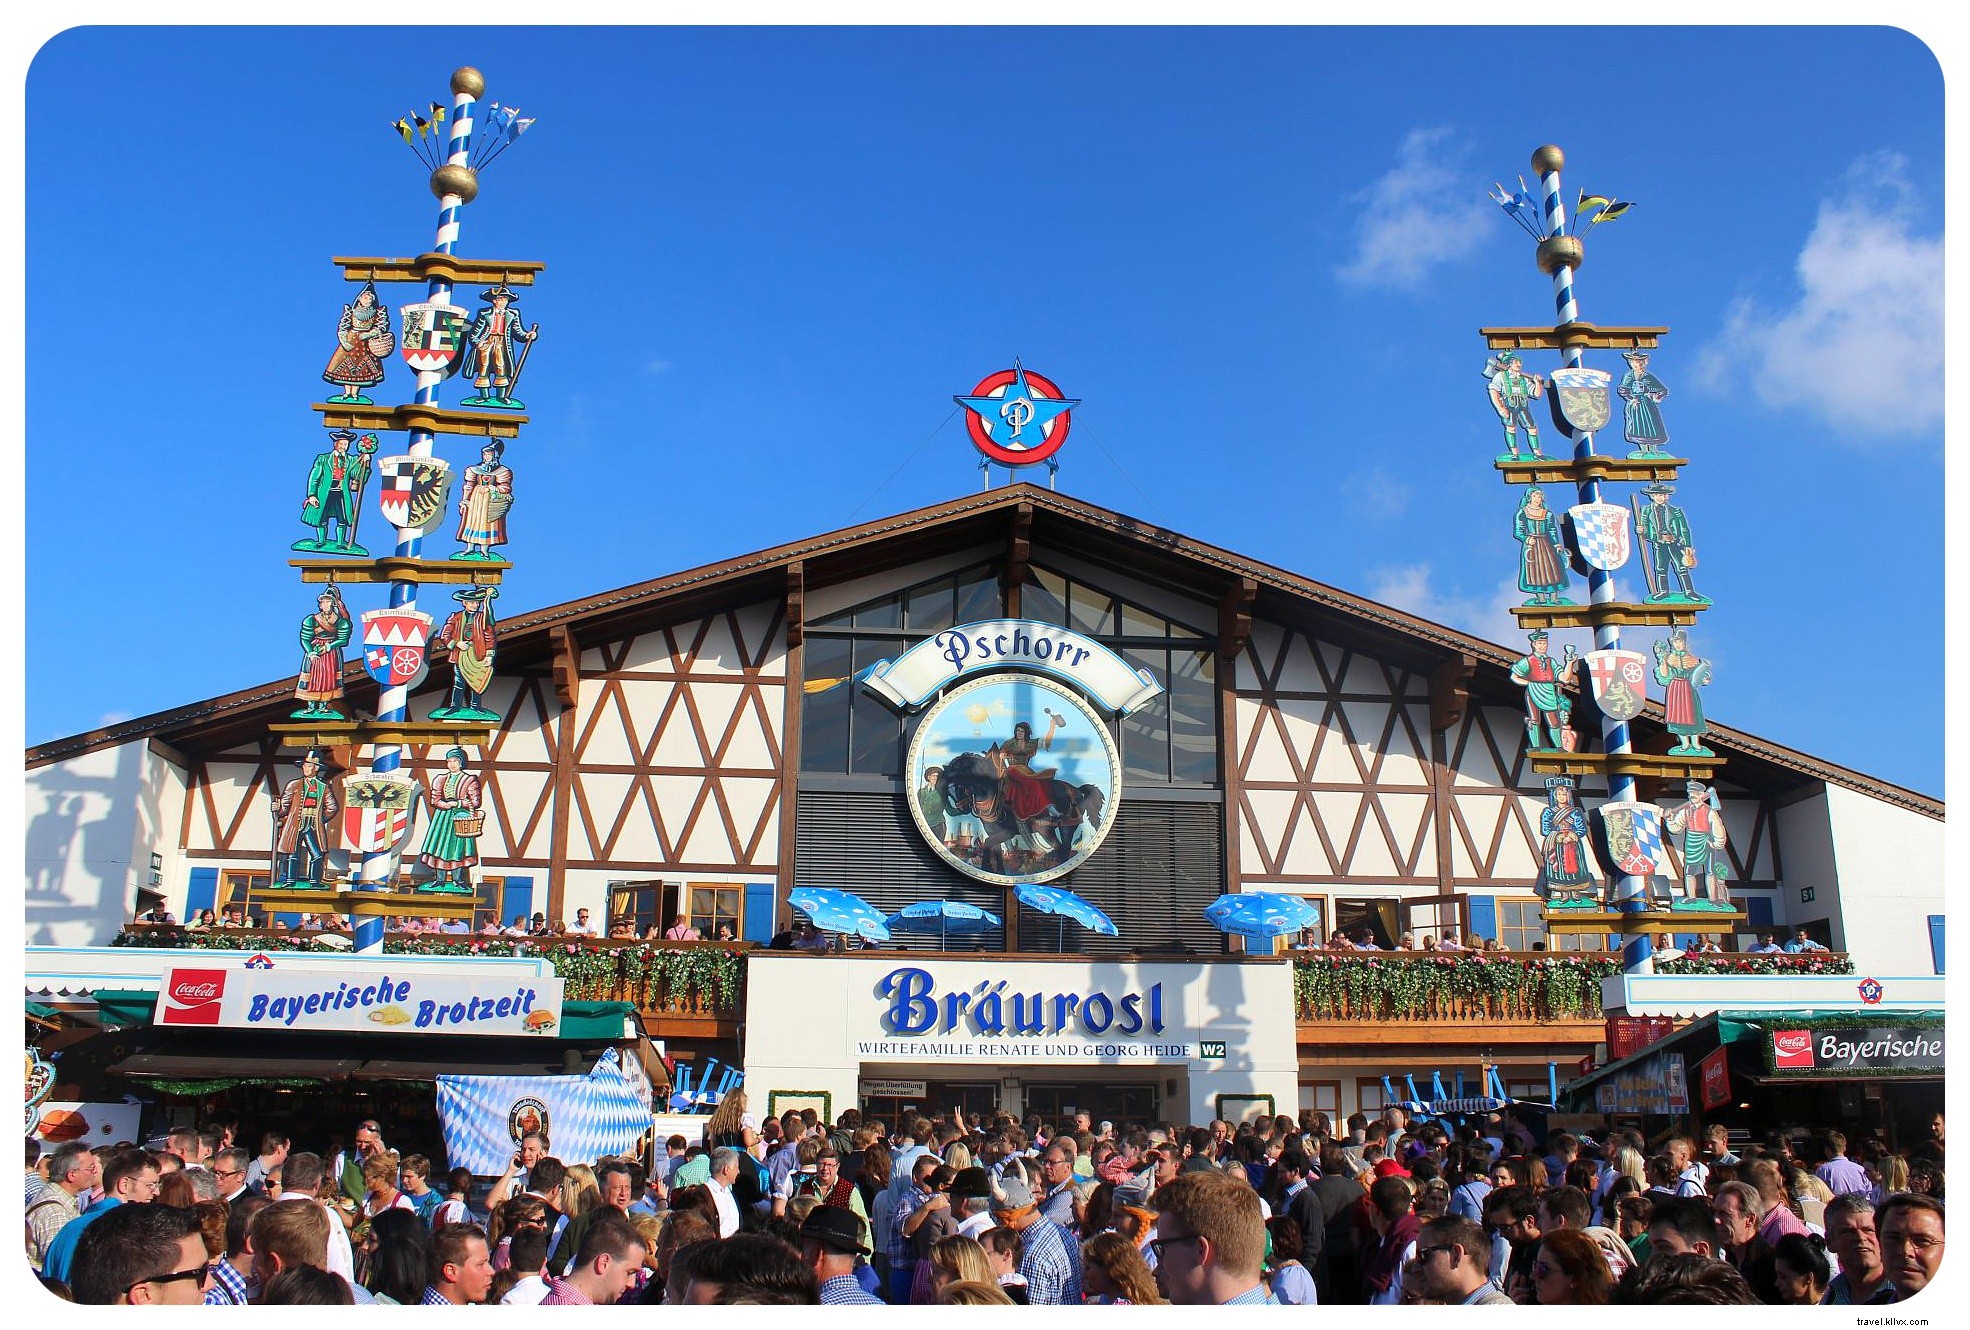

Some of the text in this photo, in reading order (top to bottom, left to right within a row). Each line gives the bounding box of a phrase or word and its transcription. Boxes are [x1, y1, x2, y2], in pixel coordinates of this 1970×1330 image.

[934, 628, 1091, 674] Pschorr
[1802, 889, 1813, 901] S1
[247, 975, 412, 1026] Bayerische
[414, 987, 536, 1028] Brotzeit
[880, 967, 1166, 1036] Bräurosl
[858, 1041, 1191, 1057] WIRTEFAMILIE RENATE UND GEORG HEIDE
[1201, 1043, 1226, 1058] W2
[1819, 1033, 1943, 1066] Bayerische
